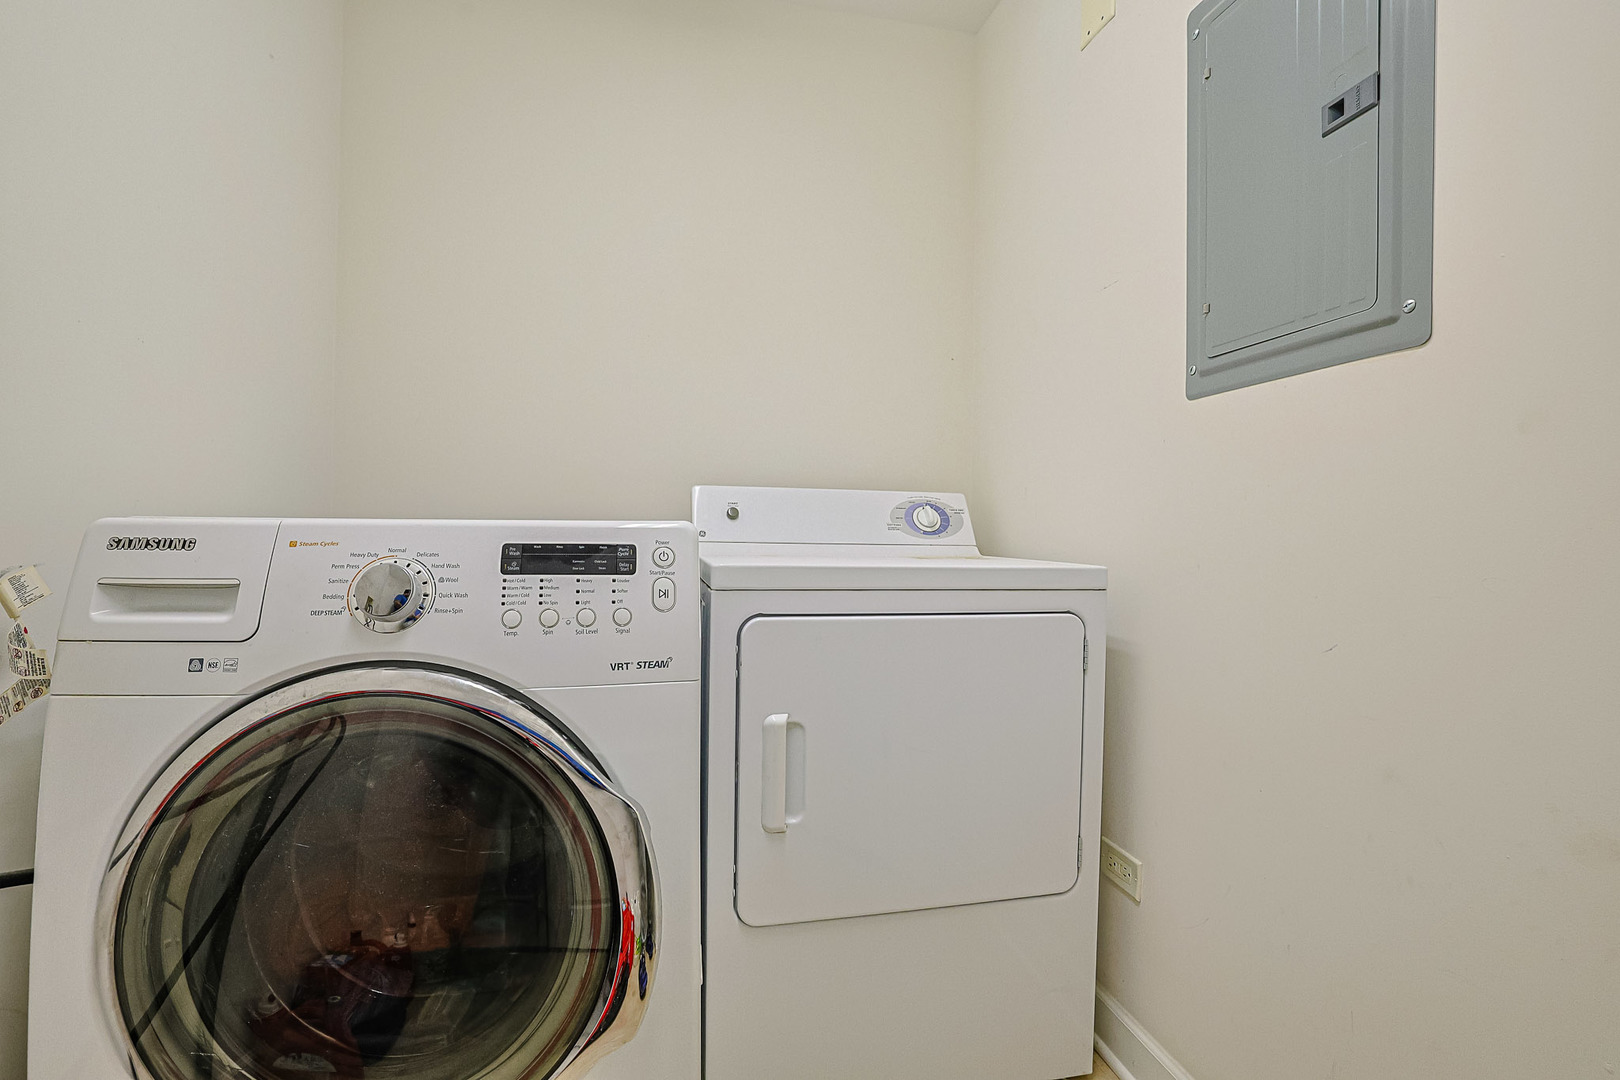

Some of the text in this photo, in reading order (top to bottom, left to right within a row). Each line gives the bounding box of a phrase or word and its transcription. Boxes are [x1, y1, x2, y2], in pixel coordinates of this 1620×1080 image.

[106, 537, 196, 551] SAMSUNG
[610, 660, 669, 671] VRT STEAM
